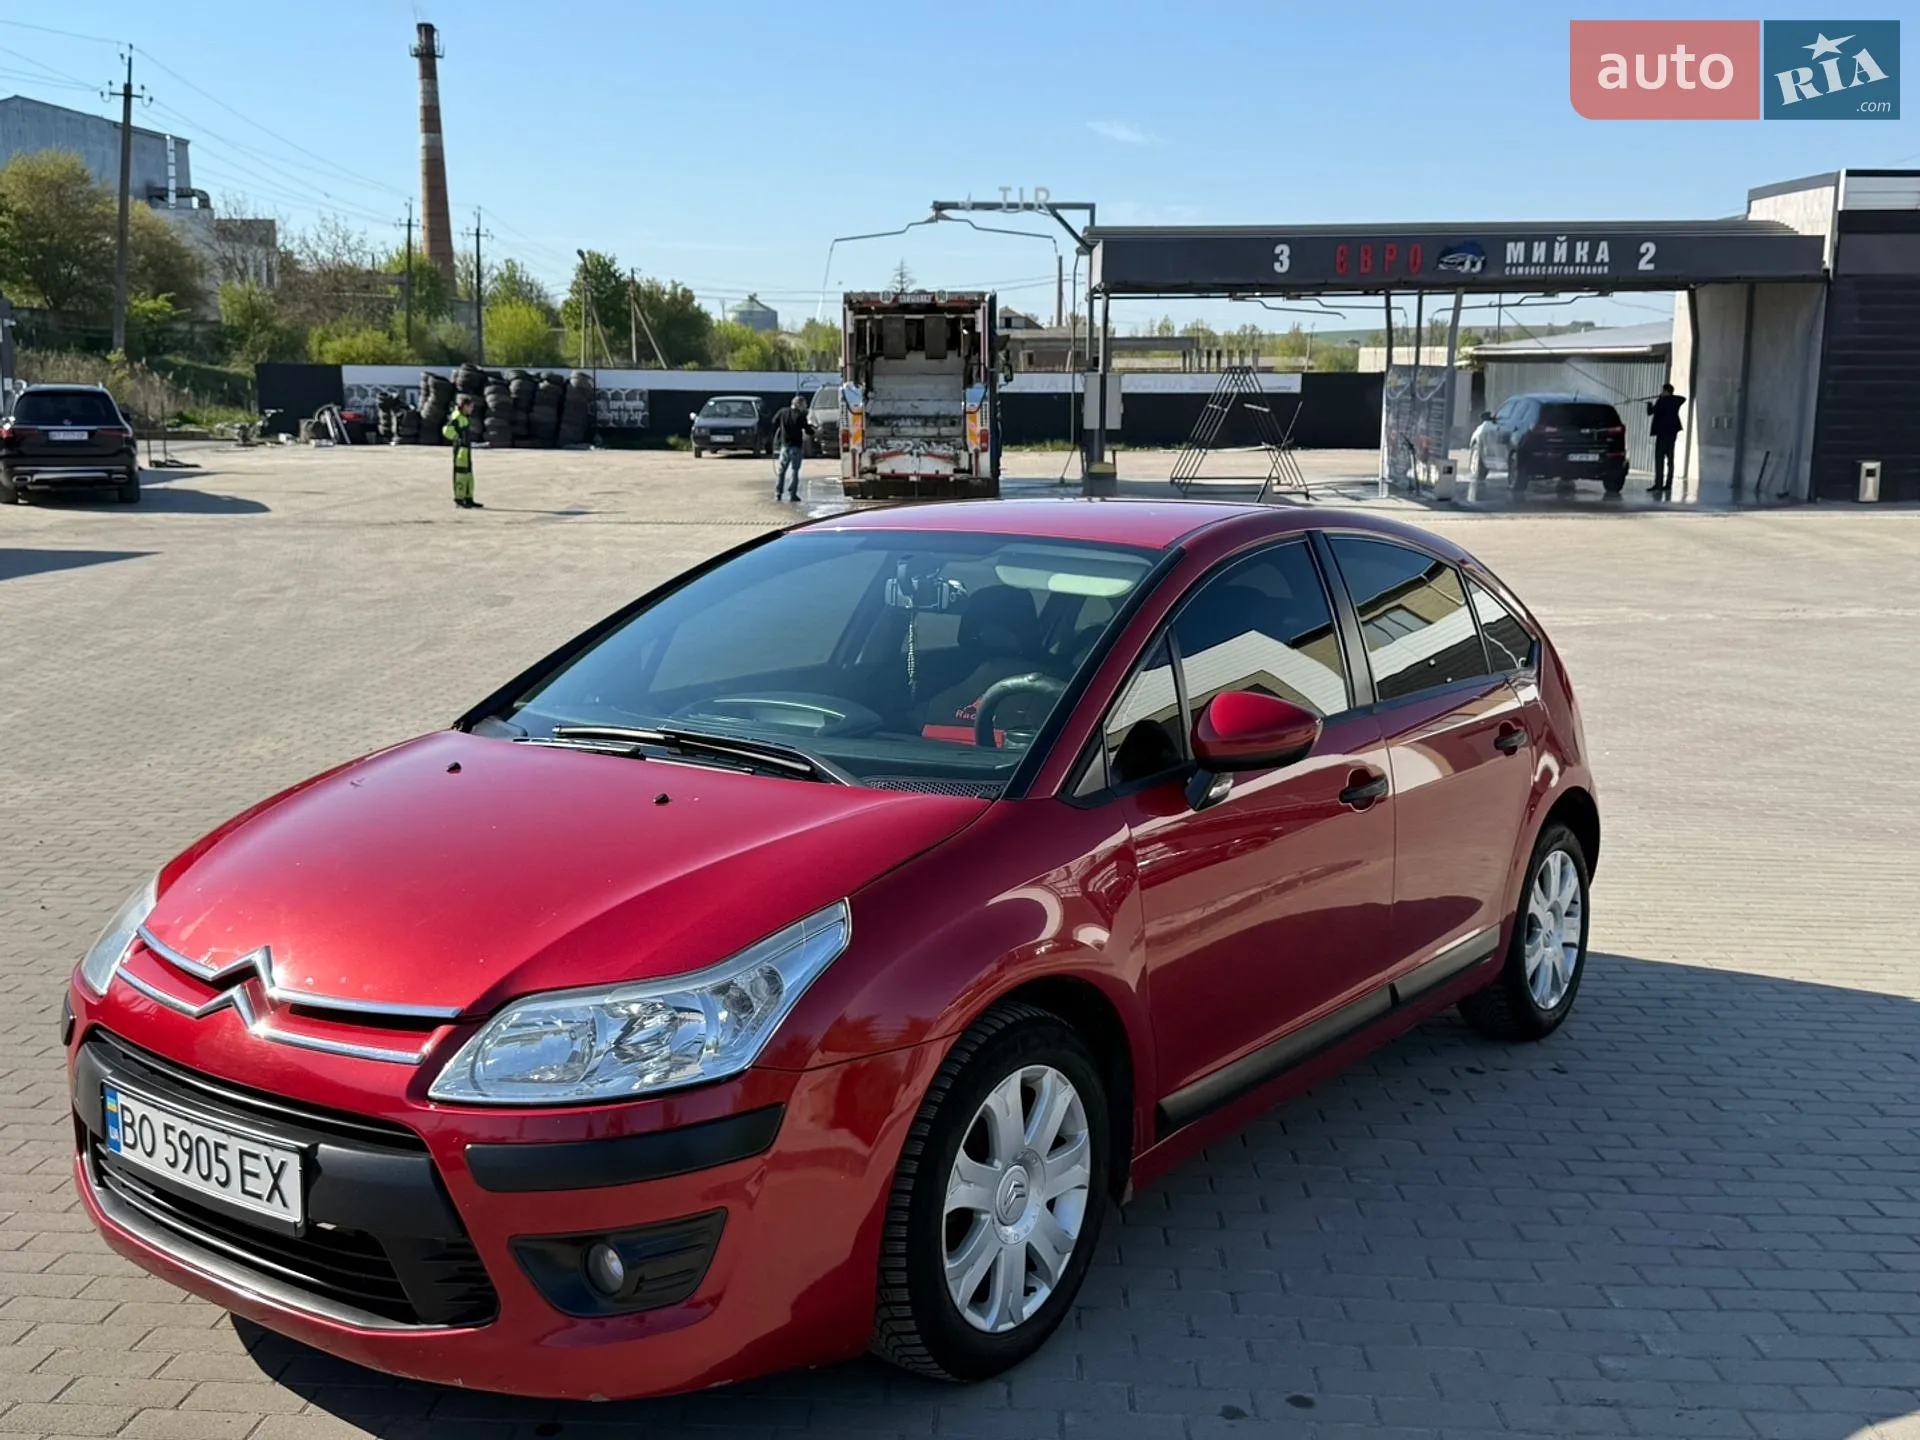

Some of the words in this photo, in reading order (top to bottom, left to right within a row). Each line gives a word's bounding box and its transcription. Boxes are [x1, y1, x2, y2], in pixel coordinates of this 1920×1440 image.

[998, 187, 1050, 211] TIR
[1273, 243, 1291, 273] 3
[1335, 243, 1423, 274] ЄВРО
[1505, 235, 1610, 264] МИЙКА
[1637, 241, 1657, 271] 2
[119, 1102, 156, 1158] BO
[162, 1121, 232, 1188] 5905
[238, 1147, 290, 1209] EX
